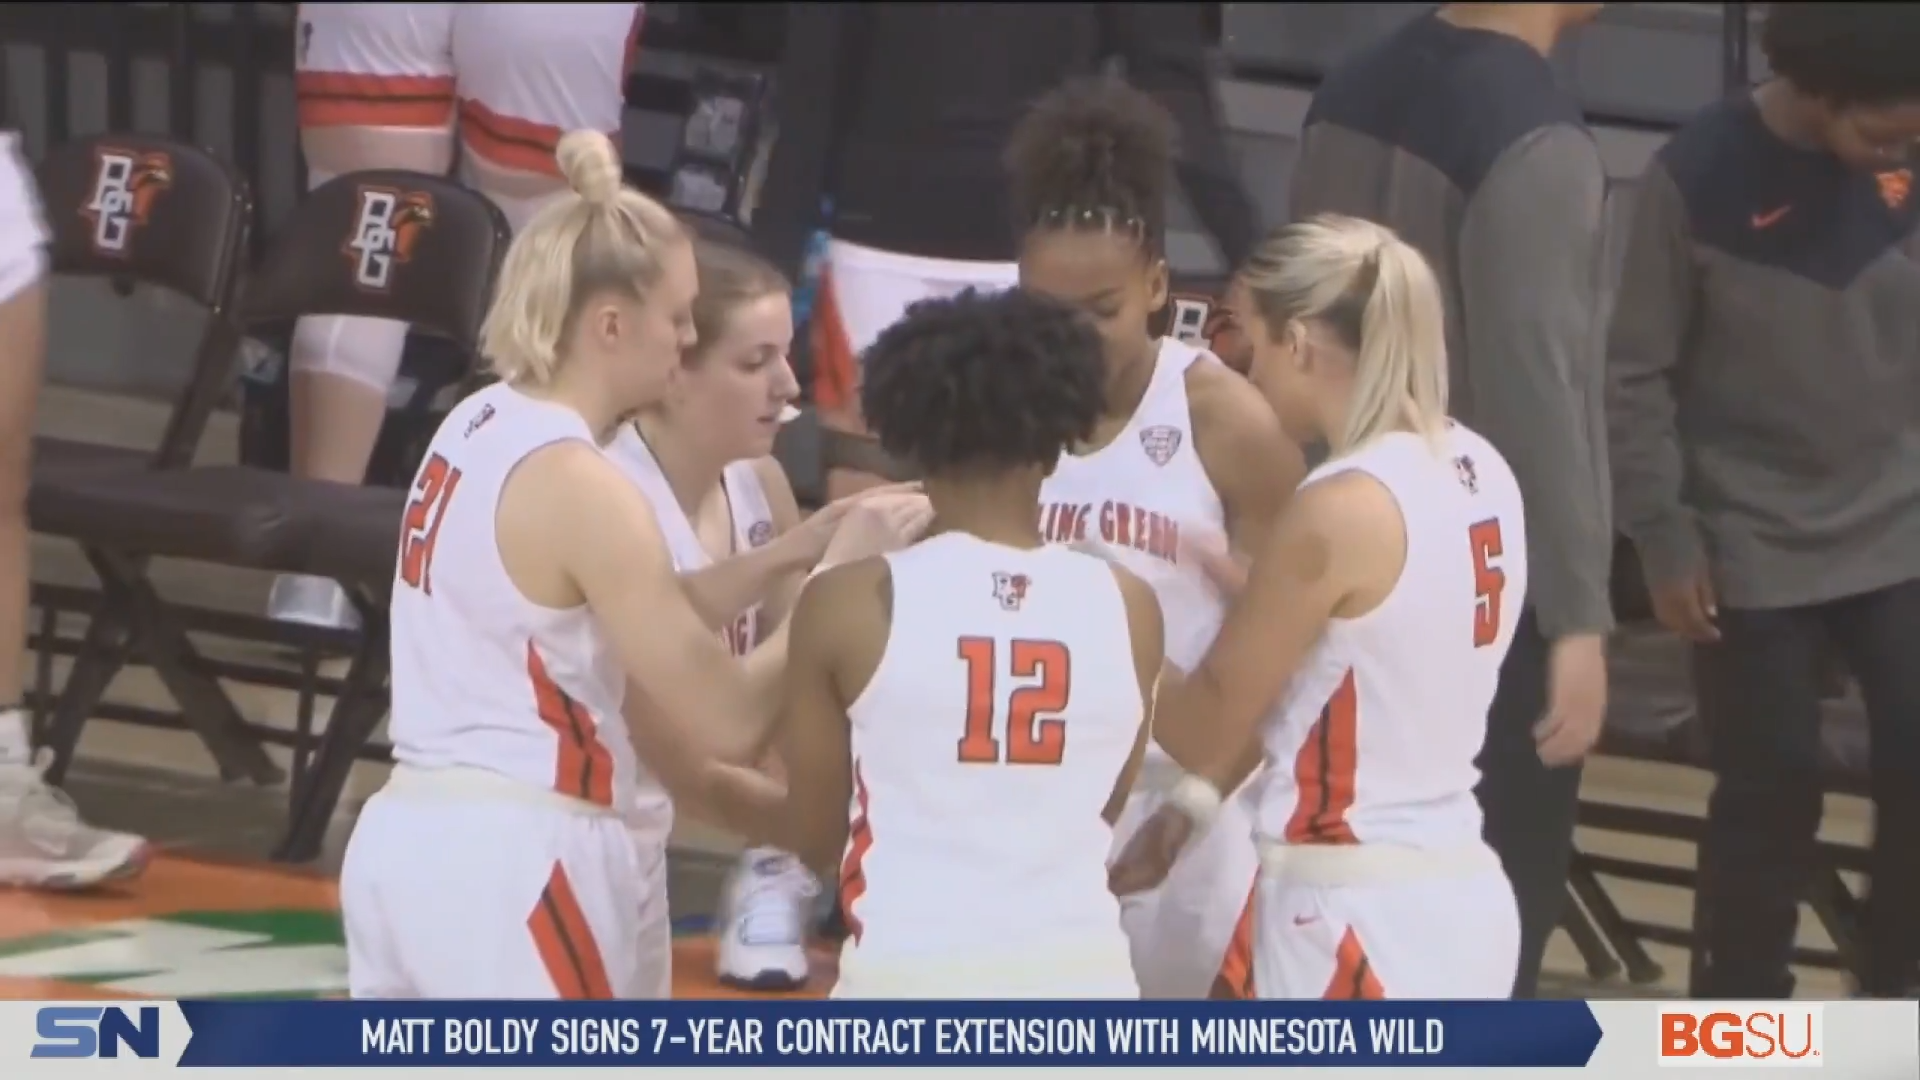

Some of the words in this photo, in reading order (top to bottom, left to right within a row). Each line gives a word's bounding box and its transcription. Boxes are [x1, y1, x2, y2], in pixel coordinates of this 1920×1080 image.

[401, 451, 463, 597] 21
[1468, 515, 1506, 649] 5
[957, 635, 1072, 766] 12
